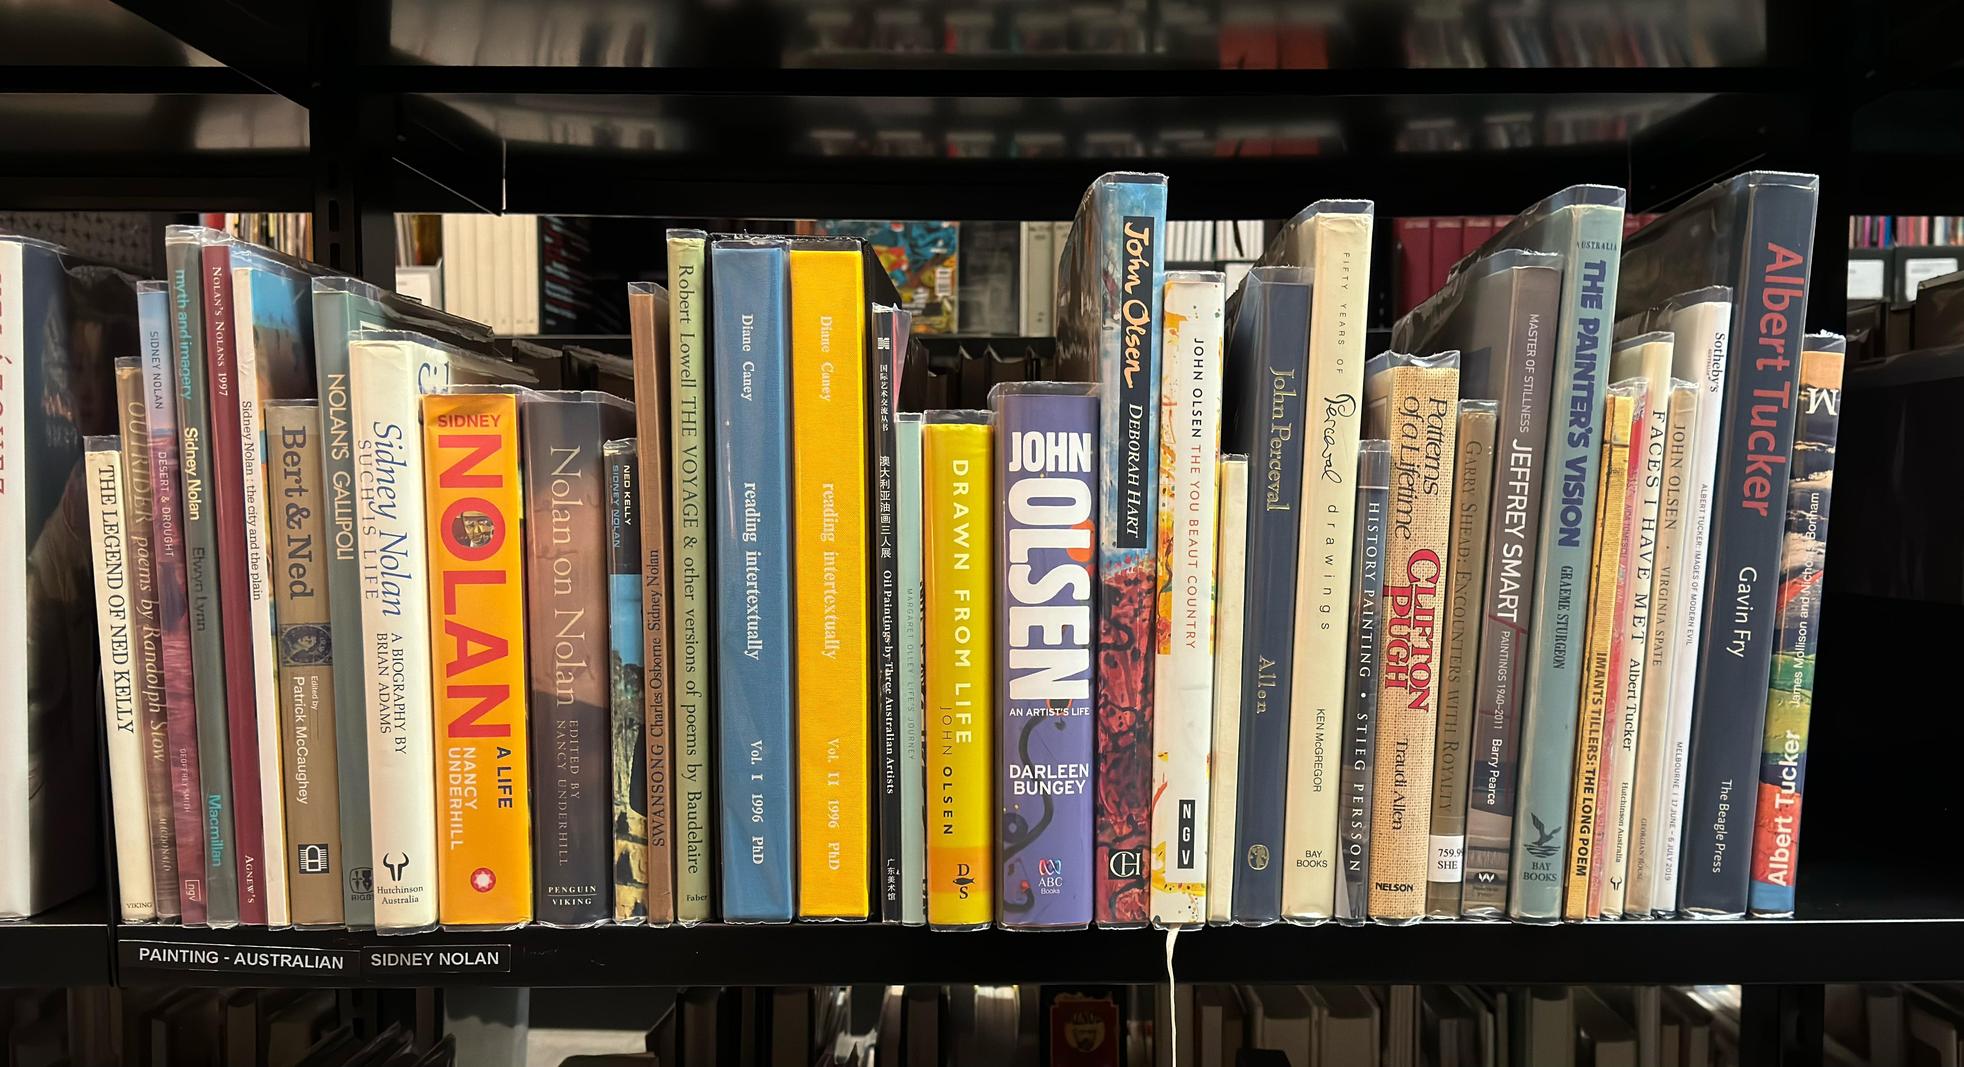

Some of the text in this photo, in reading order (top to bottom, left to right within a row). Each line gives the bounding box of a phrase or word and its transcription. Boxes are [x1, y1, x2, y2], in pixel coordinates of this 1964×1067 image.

[212, 266, 228, 396] NOLAN'S NOLANS 1997
[1122, 222, 1150, 389] John Olsen
[150, 331, 163, 409] SIDNEY NOLAN
[742, 315, 755, 400] Diane Caney
[1558, 260, 1606, 547] THE PAINTER'S VISION
[1710, 332, 1726, 392] Sotheby's
[1742, 242, 1804, 518] Albert Tucker
[438, 414, 501, 427] SIDNEY
[1009, 431, 1092, 472] JOHN
[1266, 366, 1297, 511] John Perceval
[1646, 411, 1665, 488] FACES
[184, 427, 202, 520] Sidney Nolan
[282, 426, 313, 599] Bert & Ned
[328, 374, 354, 560] NOLAN'S GALLIPOLI
[880, 456, 890, 558] 澳大利亚油画三人展
[1127, 404, 1143, 538] DEBORAH HART
[1186, 338, 1204, 649] JOHN OLSEN THE YOU BEAUT COUNTRY
[373, 422, 412, 617] Sidney Nolan
[1497, 439, 1532, 622] JEFFREY SMART
[1638, 518, 1654, 579] HAVE
[98, 464, 134, 733] THE LEGEND OF NED KELLY
[438, 435, 511, 738] NOLAN
[550, 446, 587, 706] Nolan on Nolan
[679, 264, 702, 874] Robert Lowell THE VOYAGE & other versions of poems by Baudelaire
[743, 482, 763, 659] reading intertextually
[952, 460, 971, 743] DRAWN FROM LIFE
[1008, 478, 1092, 699] OLSEN
[1727, 566, 1756, 657] Gavin Fry
[1384, 585, 1413, 689] PUGH
[1407, 549, 1441, 712] CLIFTON
[1632, 594, 1648, 643] MET
[377, 632, 391, 734] BRIAN ADAMS
[392, 632, 407, 754] A BIOGRAPHY BY
[648, 550, 664, 847] SWANSONG Charles Osborne Sidney Nolan
[882, 570, 894, 794] Oil Paintings by Three Australian Artists
[1009, 707, 1089, 716] AN ARTIST'S LIFE
[1257, 654, 1276, 714] Allen
[1350, 502, 1380, 872] HISTORY PAINTING STIEG PERSSON
[1623, 659, 1640, 751] Albert Tucker
[294, 677, 308, 804] Patrick McCaughey
[463, 747, 478, 810] NANCY
[497, 746, 512, 808] A LIFE
[750, 740, 762, 765] Vol.
[940, 707, 953, 834] JOHN OLSEN
[1009, 764, 1089, 778] DARLEEN
[1313, 708, 1325, 792] KEN McGREGOR
[1392, 739, 1407, 830] Traudi Allen
[1487, 738, 1502, 805] Barry Pearce
[1576, 652, 1607, 876] IMANTS TILLERS: THE LONG POEM
[209, 794, 223, 867] Macmillan
[448, 747, 463, 850] UNDERHILL
[752, 794, 763, 822] 1996
[1014, 780, 1086, 794] BUNGEY
[1713, 780, 1732, 873] The Beagle Press
[1768, 730, 1800, 886] Albert Tucker
[186, 883, 196, 902] ngv
[377, 885, 423, 894] Hutchinson
[548, 885, 596, 893] PENGUIN
[752, 837, 763, 864] PhD
[1039, 877, 1062, 886] ABC
[1306, 850, 1322, 858] BAY
[1375, 883, 1413, 892] NELSON
[1438, 861, 1458, 869] SHE
[1523, 873, 1557, 881] BOOKS
[382, 895, 418, 904] Australia
[140, 948, 219, 964] PAINTING
[233, 953, 343, 970] AUSTRALIAN
[370, 952, 499, 966] SIDNEY NOLAN
